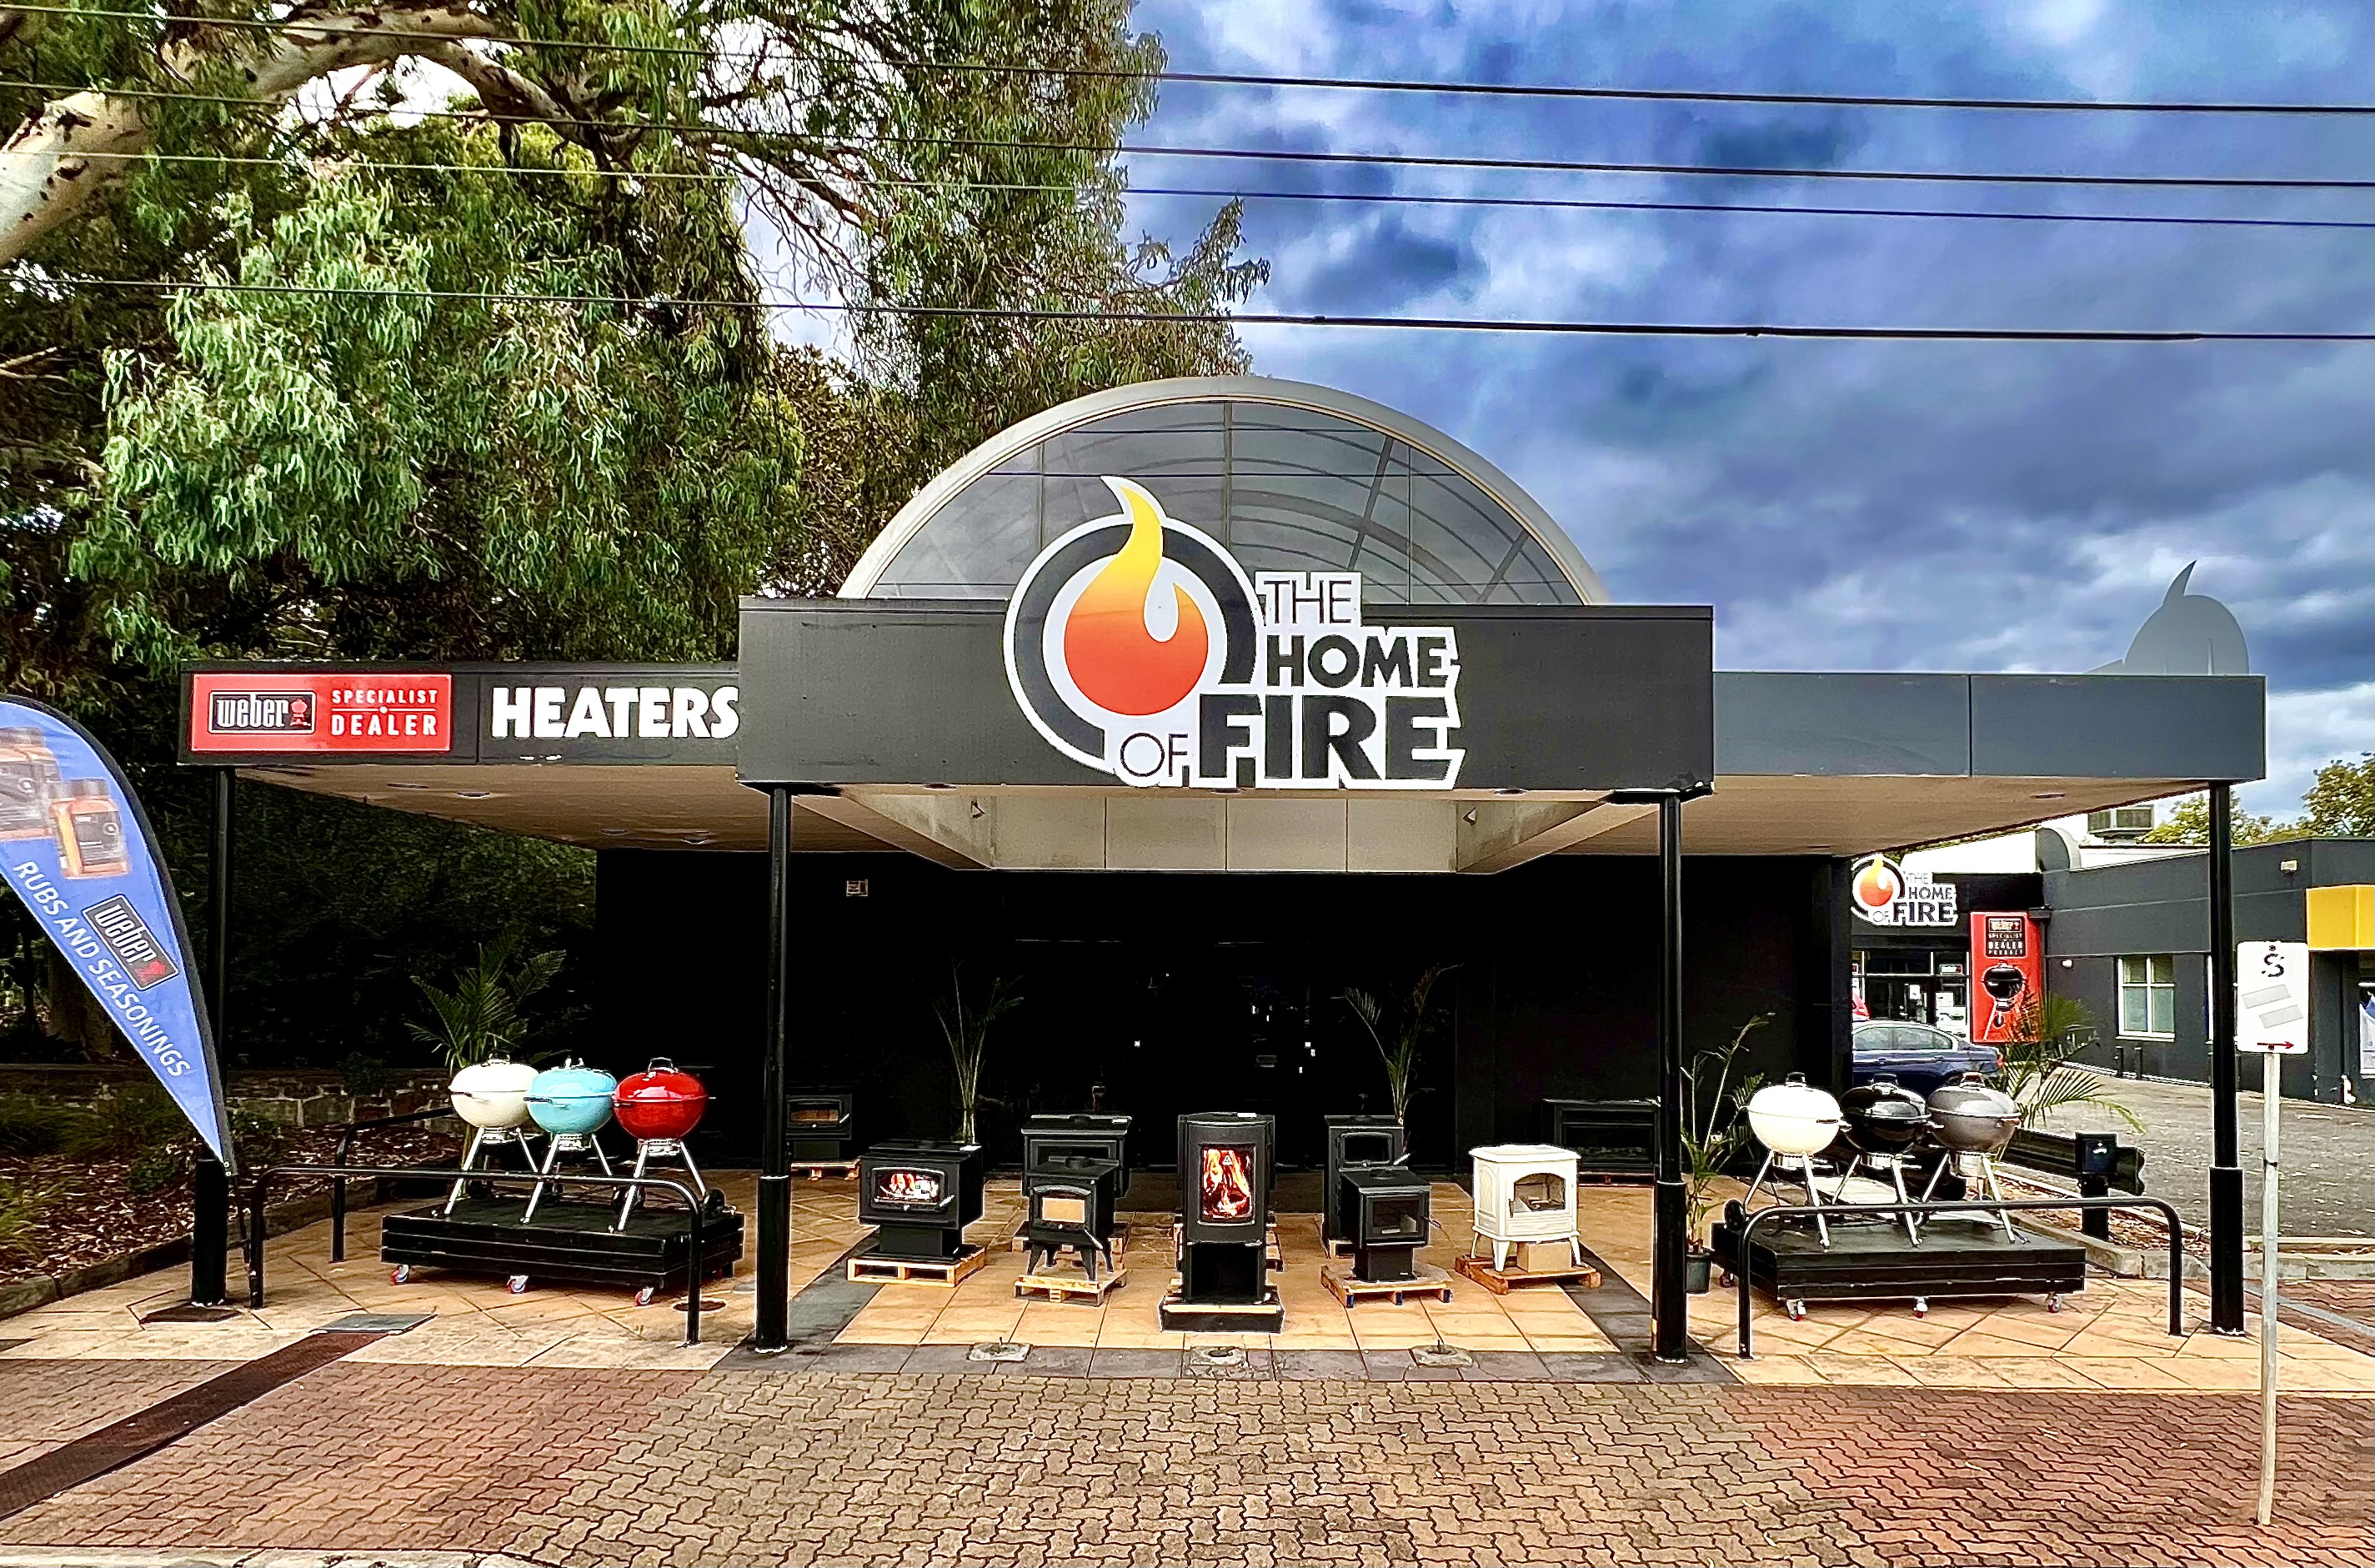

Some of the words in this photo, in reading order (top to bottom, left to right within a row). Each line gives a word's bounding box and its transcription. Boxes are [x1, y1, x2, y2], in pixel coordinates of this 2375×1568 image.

[1263, 579, 1353, 624] THE
[1266, 634, 1449, 689] HOME
[216, 694, 289, 728] weber
[332, 689, 438, 704] SPECIALIST
[491, 686, 739, 739] HEATERS
[331, 714, 437, 736] DEALER
[1120, 732, 1189, 778] OF
[1199, 694, 1453, 781] FIRE
[1907, 872, 1929, 884] THE
[1908, 886, 1952, 899] HOME
[1872, 910, 1890, 923] OF
[1892, 901, 1954, 923] FIRE
[94, 904, 157, 963] weber
[13, 861, 69, 915] RUBS
[53, 916, 100, 959] AND
[88, 958, 191, 1077] SEASONINGS
